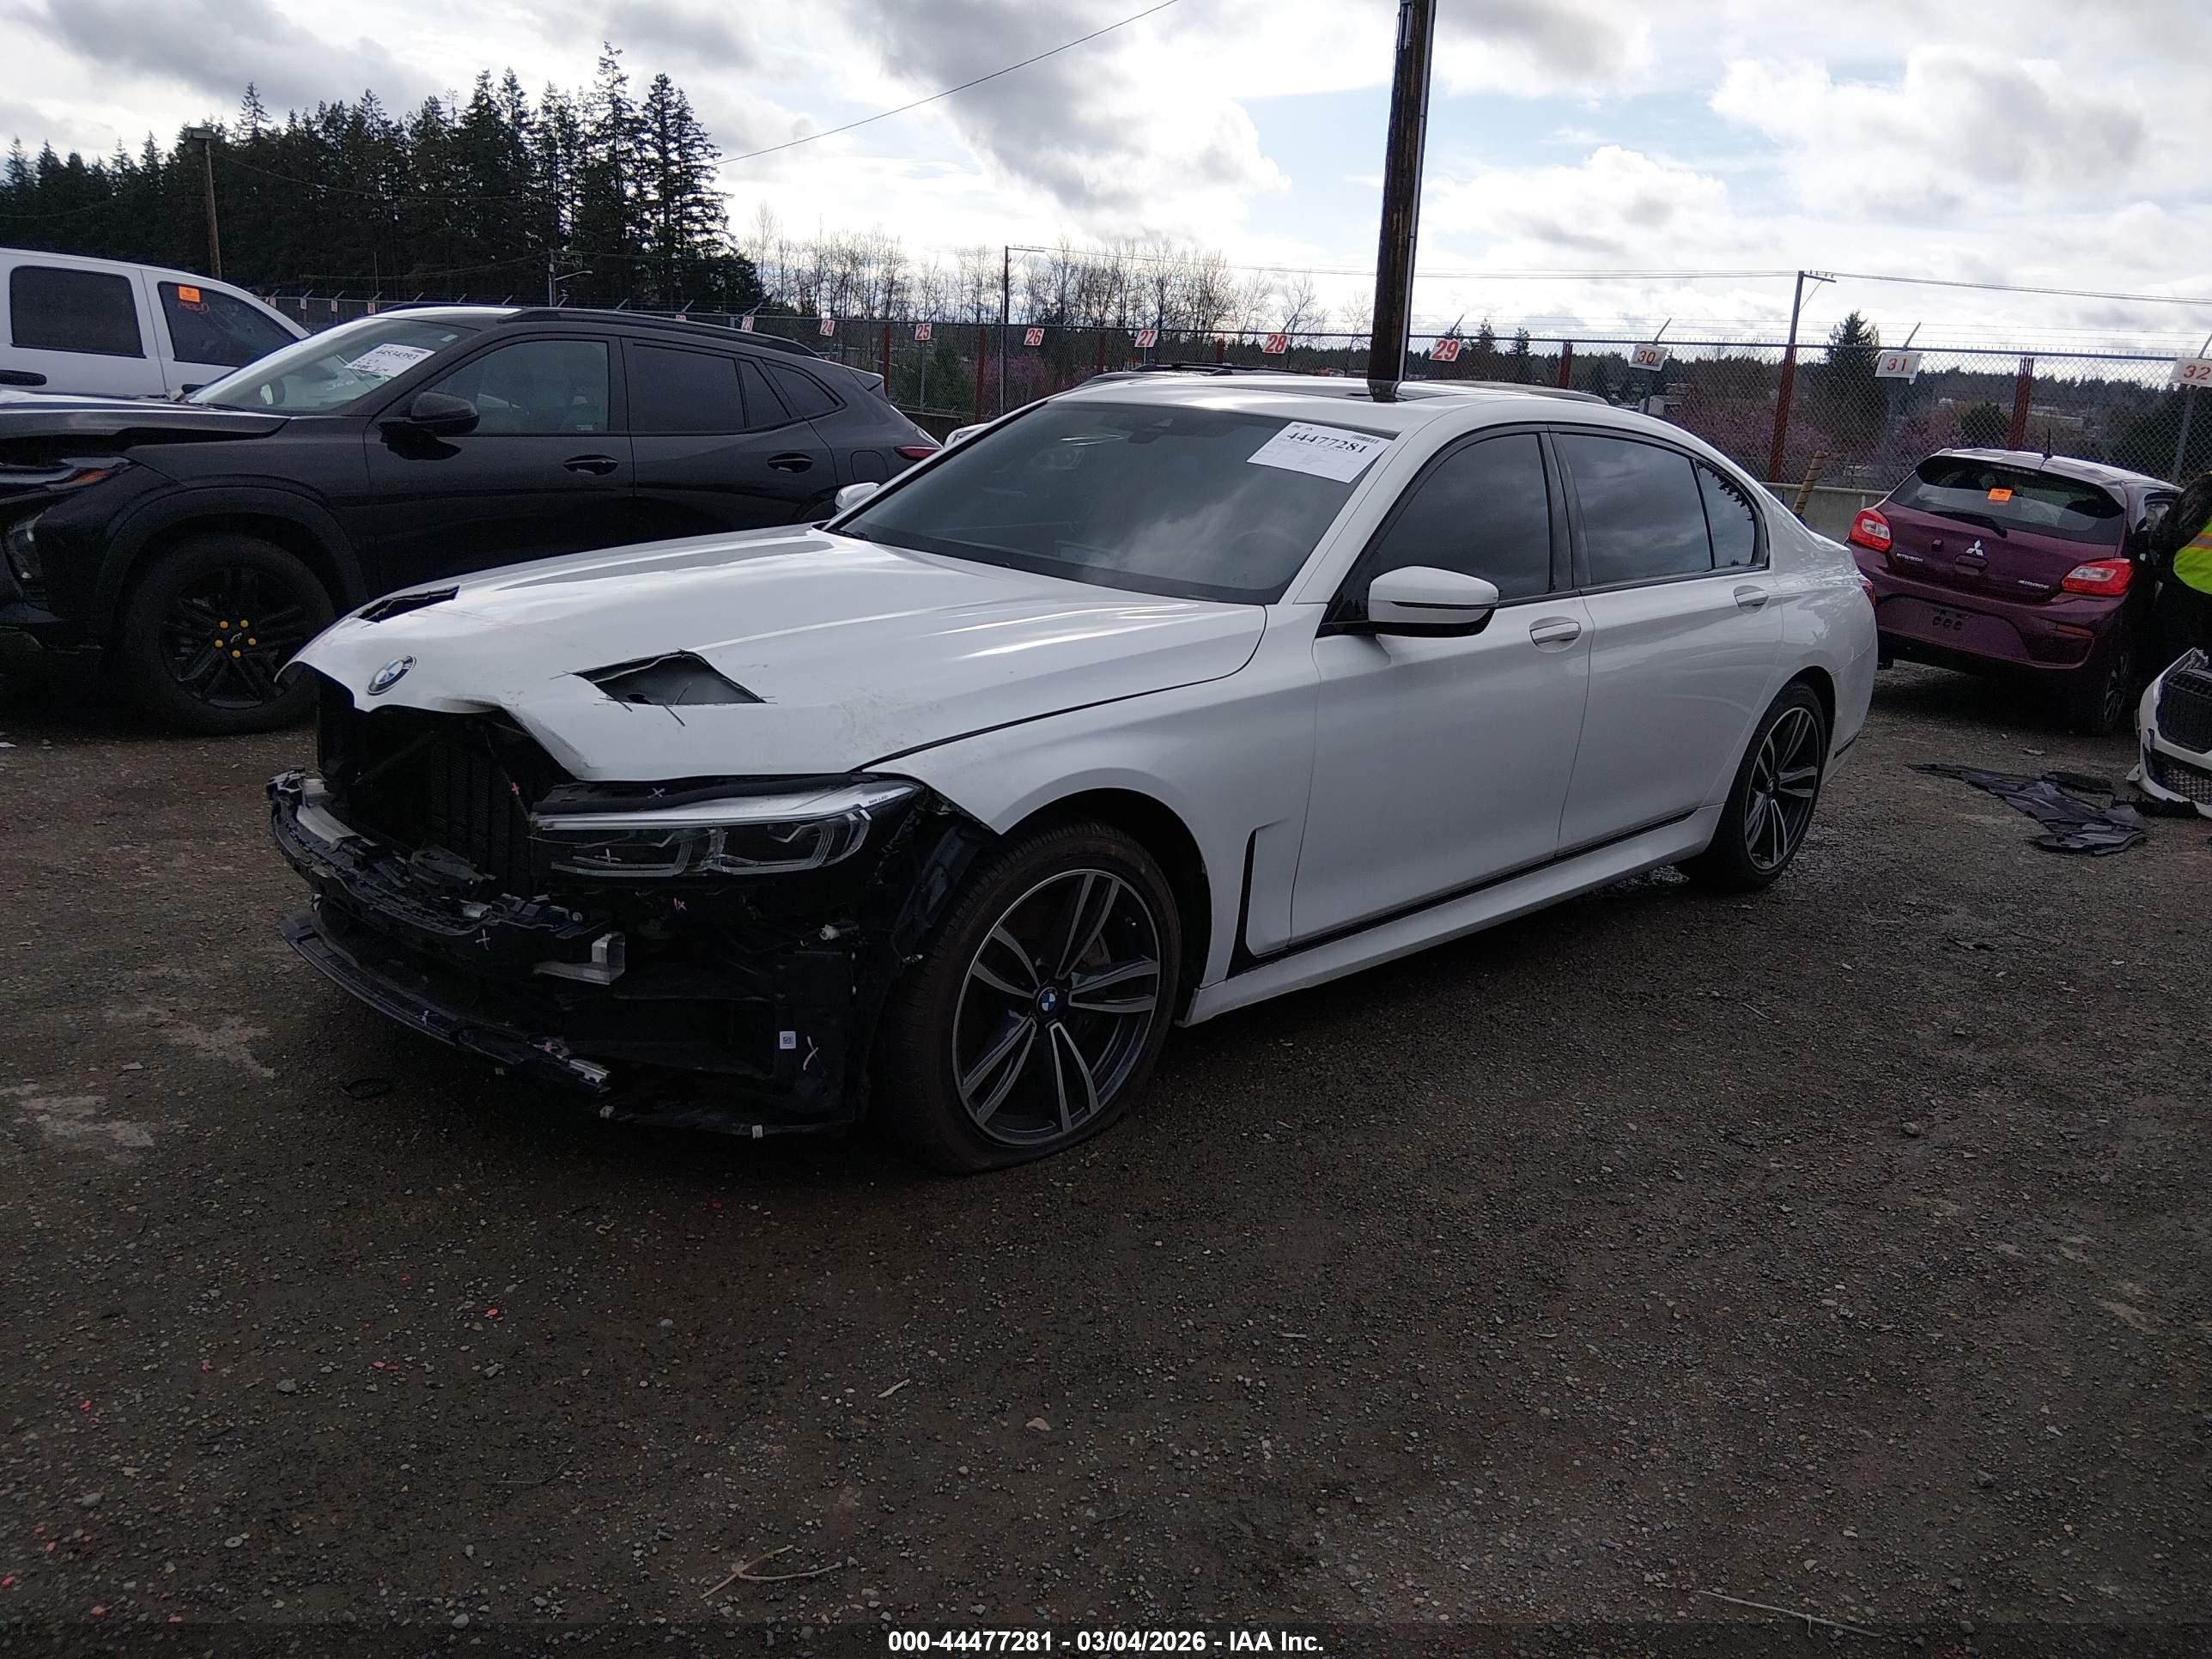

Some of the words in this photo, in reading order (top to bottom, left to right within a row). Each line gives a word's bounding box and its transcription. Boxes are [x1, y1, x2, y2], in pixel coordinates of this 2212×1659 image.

[743, 317, 752, 331] 23
[821, 320, 834, 335] 24
[916, 324, 930, 339] 25
[1025, 329, 1042, 344] 26
[1137, 330, 1156, 346] 27
[1264, 334, 1288, 352] 28
[1431, 340, 1458, 360] 29
[1637, 350, 1656, 364] 30
[1887, 357, 1907, 371] 31
[2184, 364, 2211, 380] 32
[1287, 431, 1368, 453] 44477281
